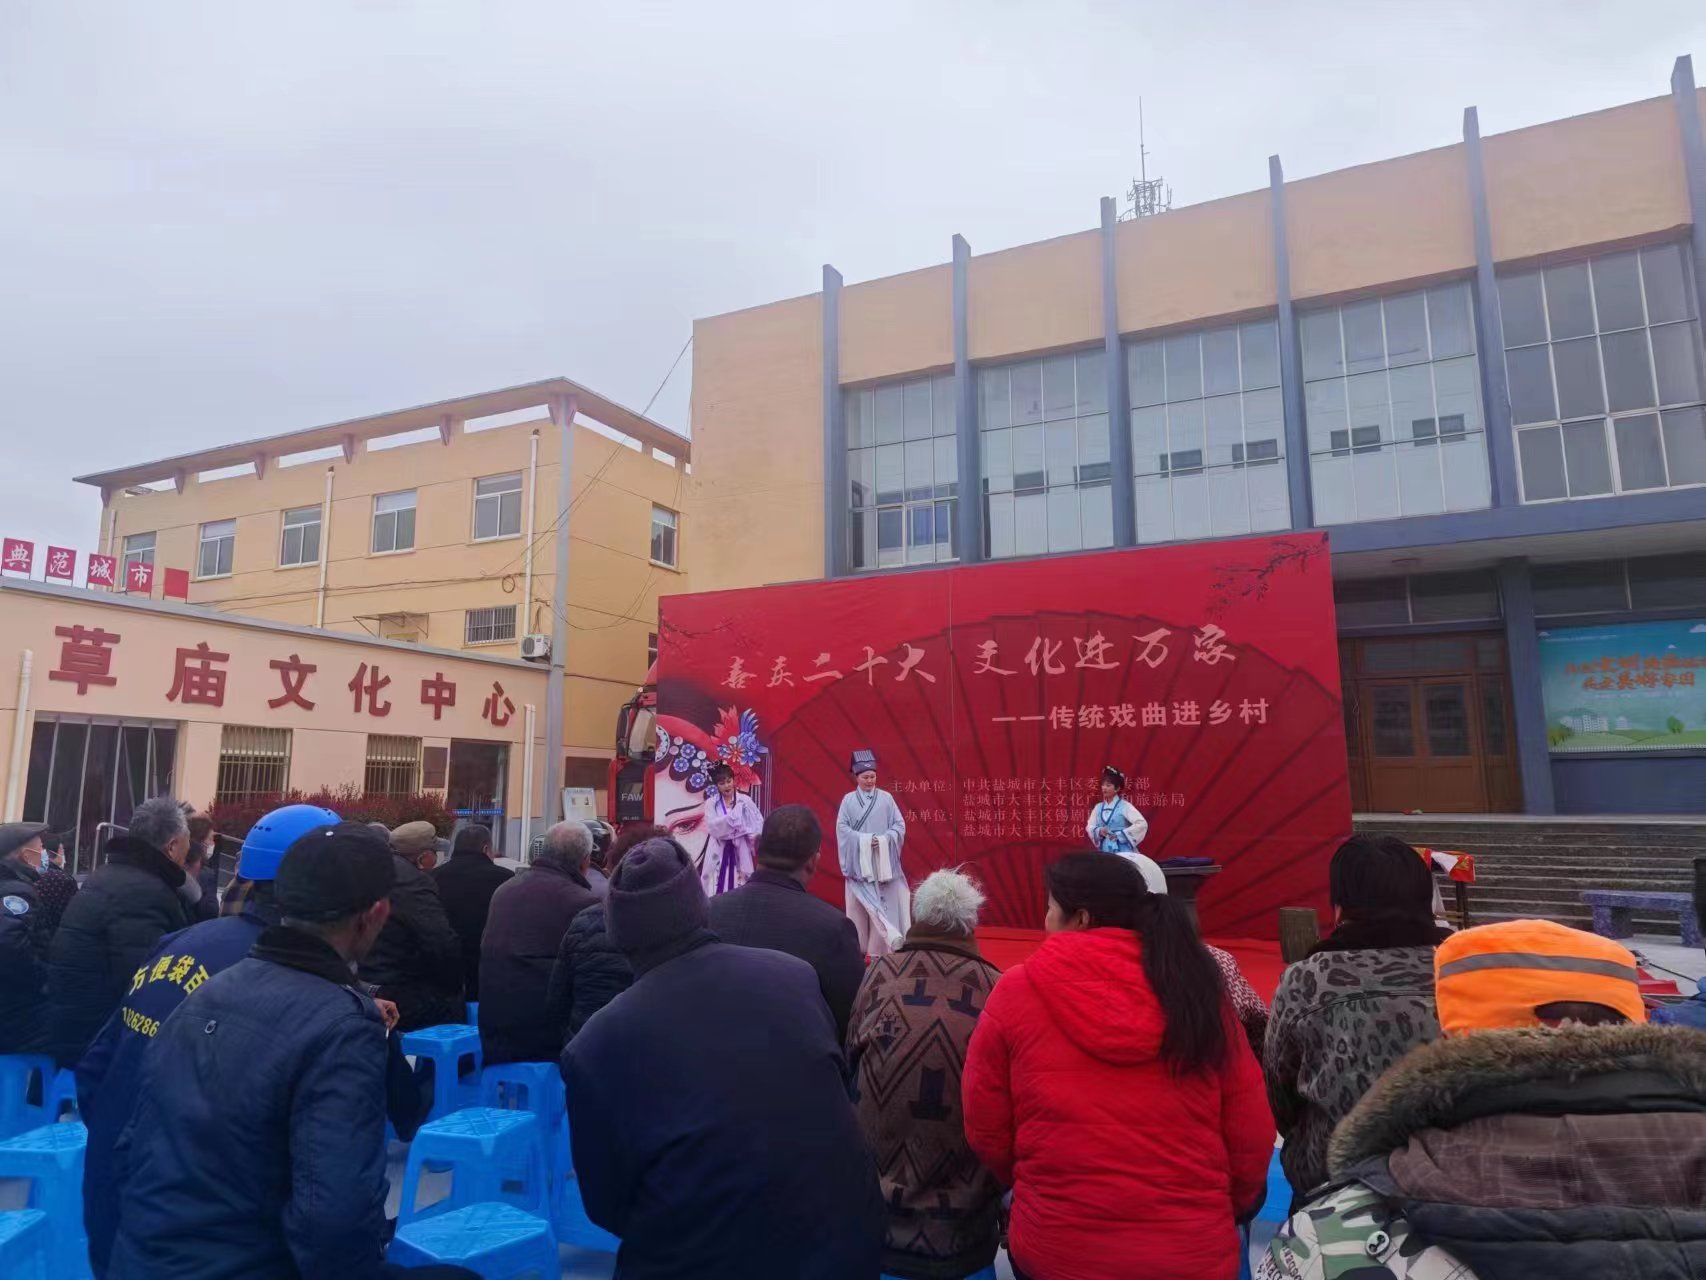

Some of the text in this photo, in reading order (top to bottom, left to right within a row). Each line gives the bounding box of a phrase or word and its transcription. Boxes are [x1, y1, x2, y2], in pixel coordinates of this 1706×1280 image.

[4, 543, 152, 589] 典范城市
[720, 624, 1237, 689] 喜庆二十大 文化进万家
[49, 623, 515, 727] 草庙文化中心
[963, 776, 1151, 791] 中共盐城市大丰区委传部
[621, 793, 644, 801] FAW
[962, 791, 1186, 808] 盐城市大丰区文化广和旅游局
[904, 808, 1092, 823] 办单位： 盐城市大丰区锡剧
[962, 822, 1086, 838] 盐城市大丰区文化
